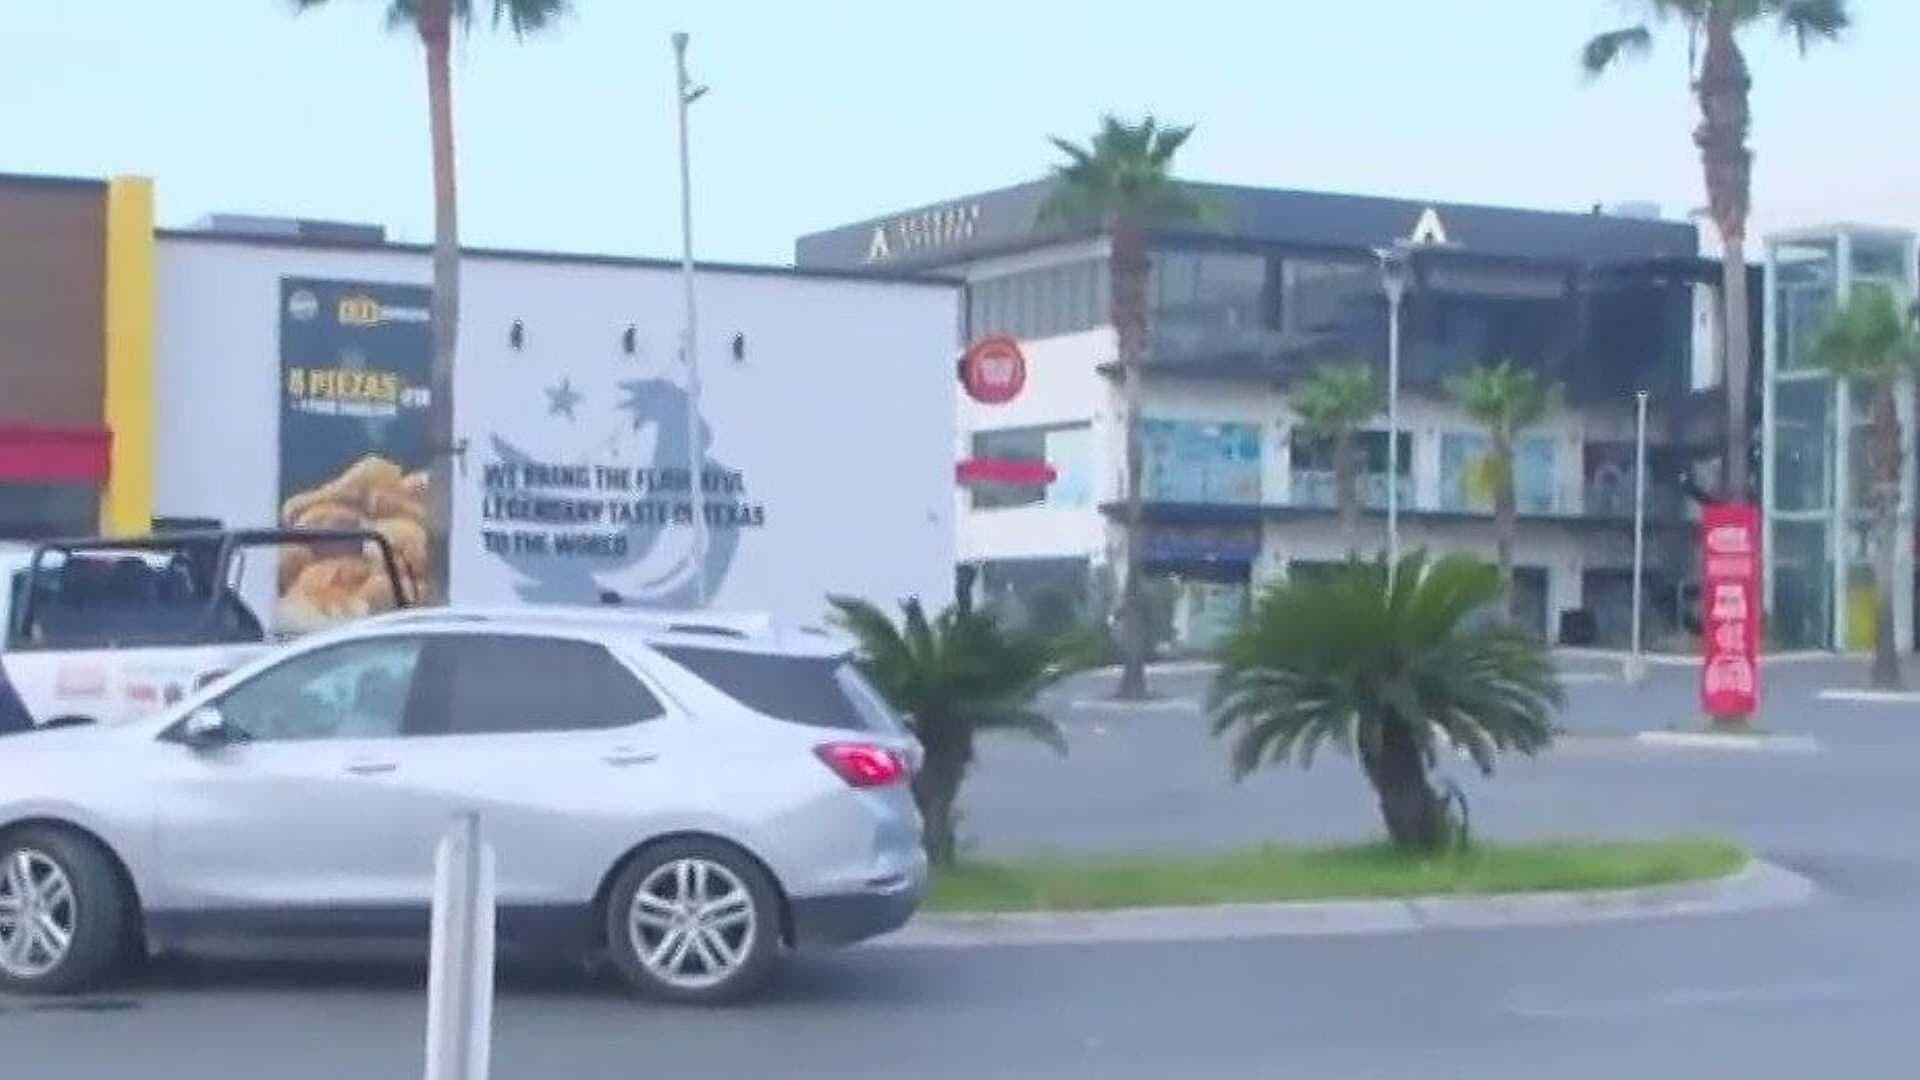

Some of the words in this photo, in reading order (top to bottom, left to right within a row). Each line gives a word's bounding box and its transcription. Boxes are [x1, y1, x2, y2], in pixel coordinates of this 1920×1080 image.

[310, 369, 396, 401] PIEZAS
[484, 464, 514, 488] WE
[524, 465, 591, 488] BRING
[596, 466, 630, 490] THE
[482, 496, 603, 524] LEGENDARY
[608, 499, 668, 526] TASTE
[703, 502, 765, 528] TEXAS
[484, 531, 510, 552] TO
[514, 532, 546, 554] THE
[553, 534, 628, 558] WORLD
